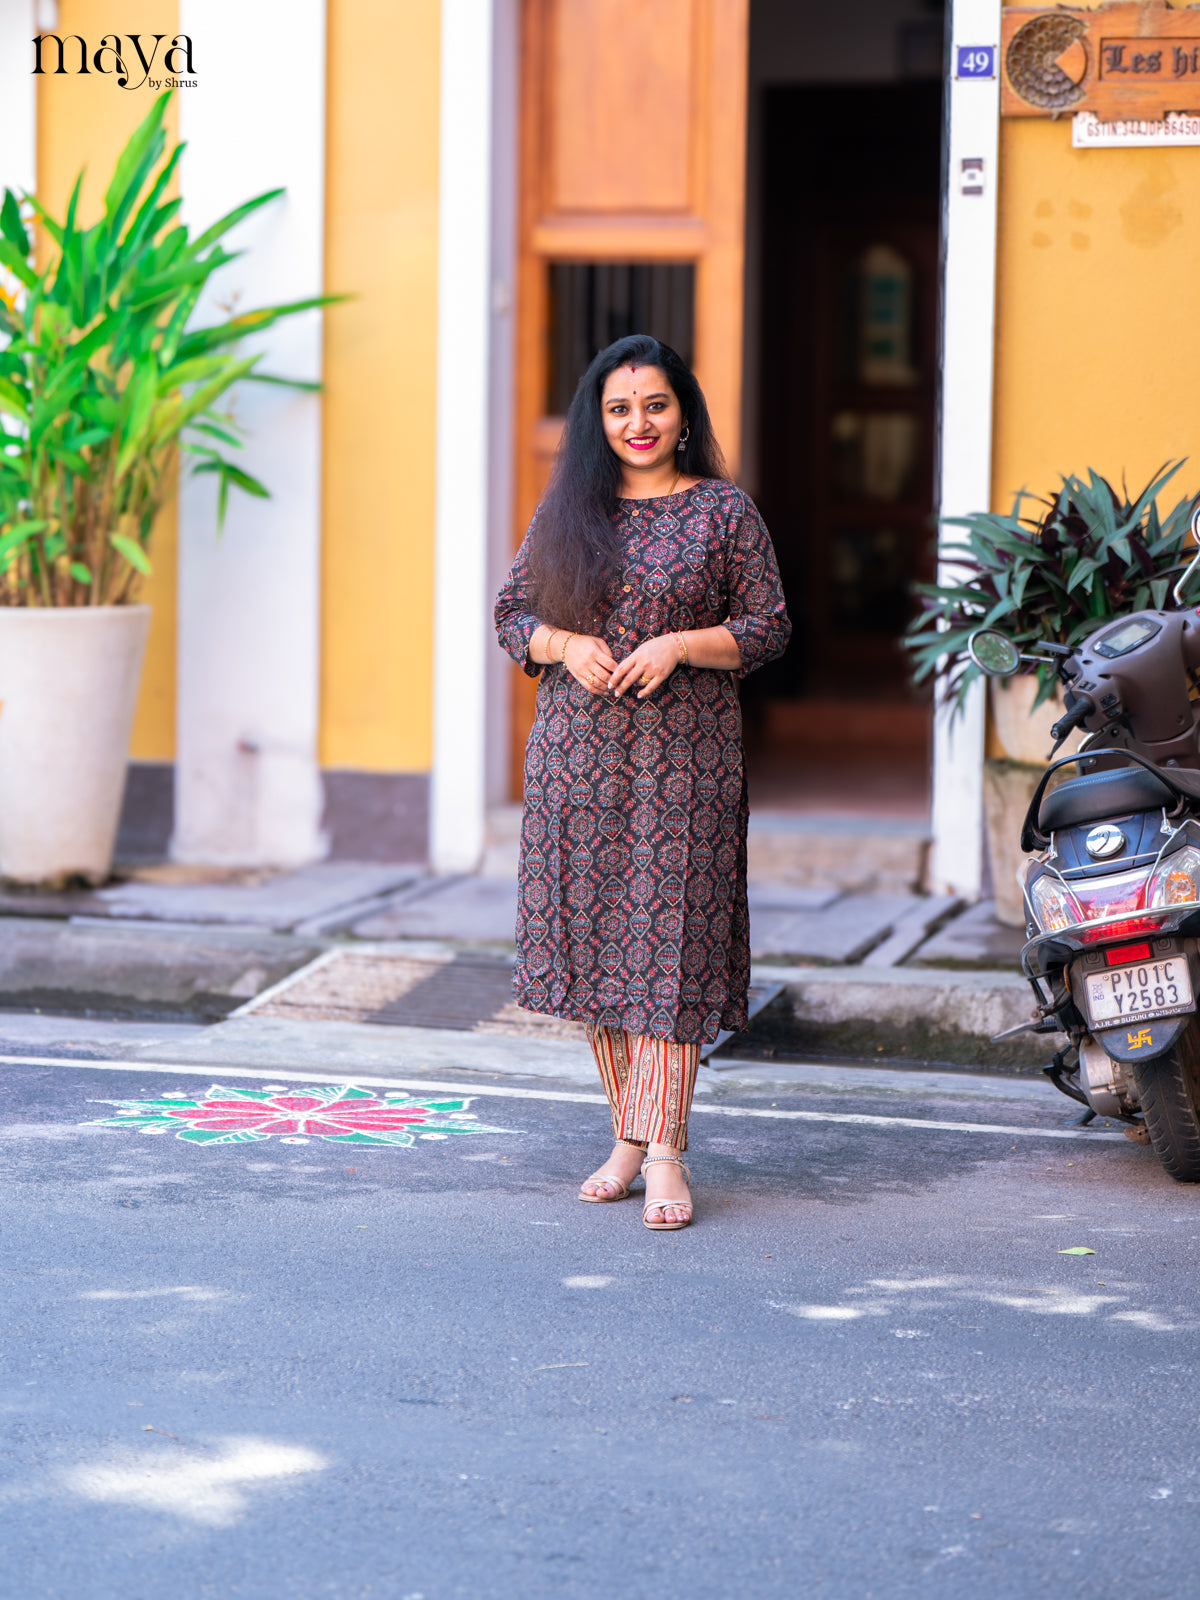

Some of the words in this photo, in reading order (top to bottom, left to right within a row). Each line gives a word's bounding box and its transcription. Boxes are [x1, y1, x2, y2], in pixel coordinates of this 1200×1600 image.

[962, 52, 990, 73] 49
[1102, 45, 1162, 73] Les
[1111, 962, 1175, 993] PY01C
[1114, 984, 1179, 1014] Y2583
[1121, 1013, 1147, 1024] SUZUKI
